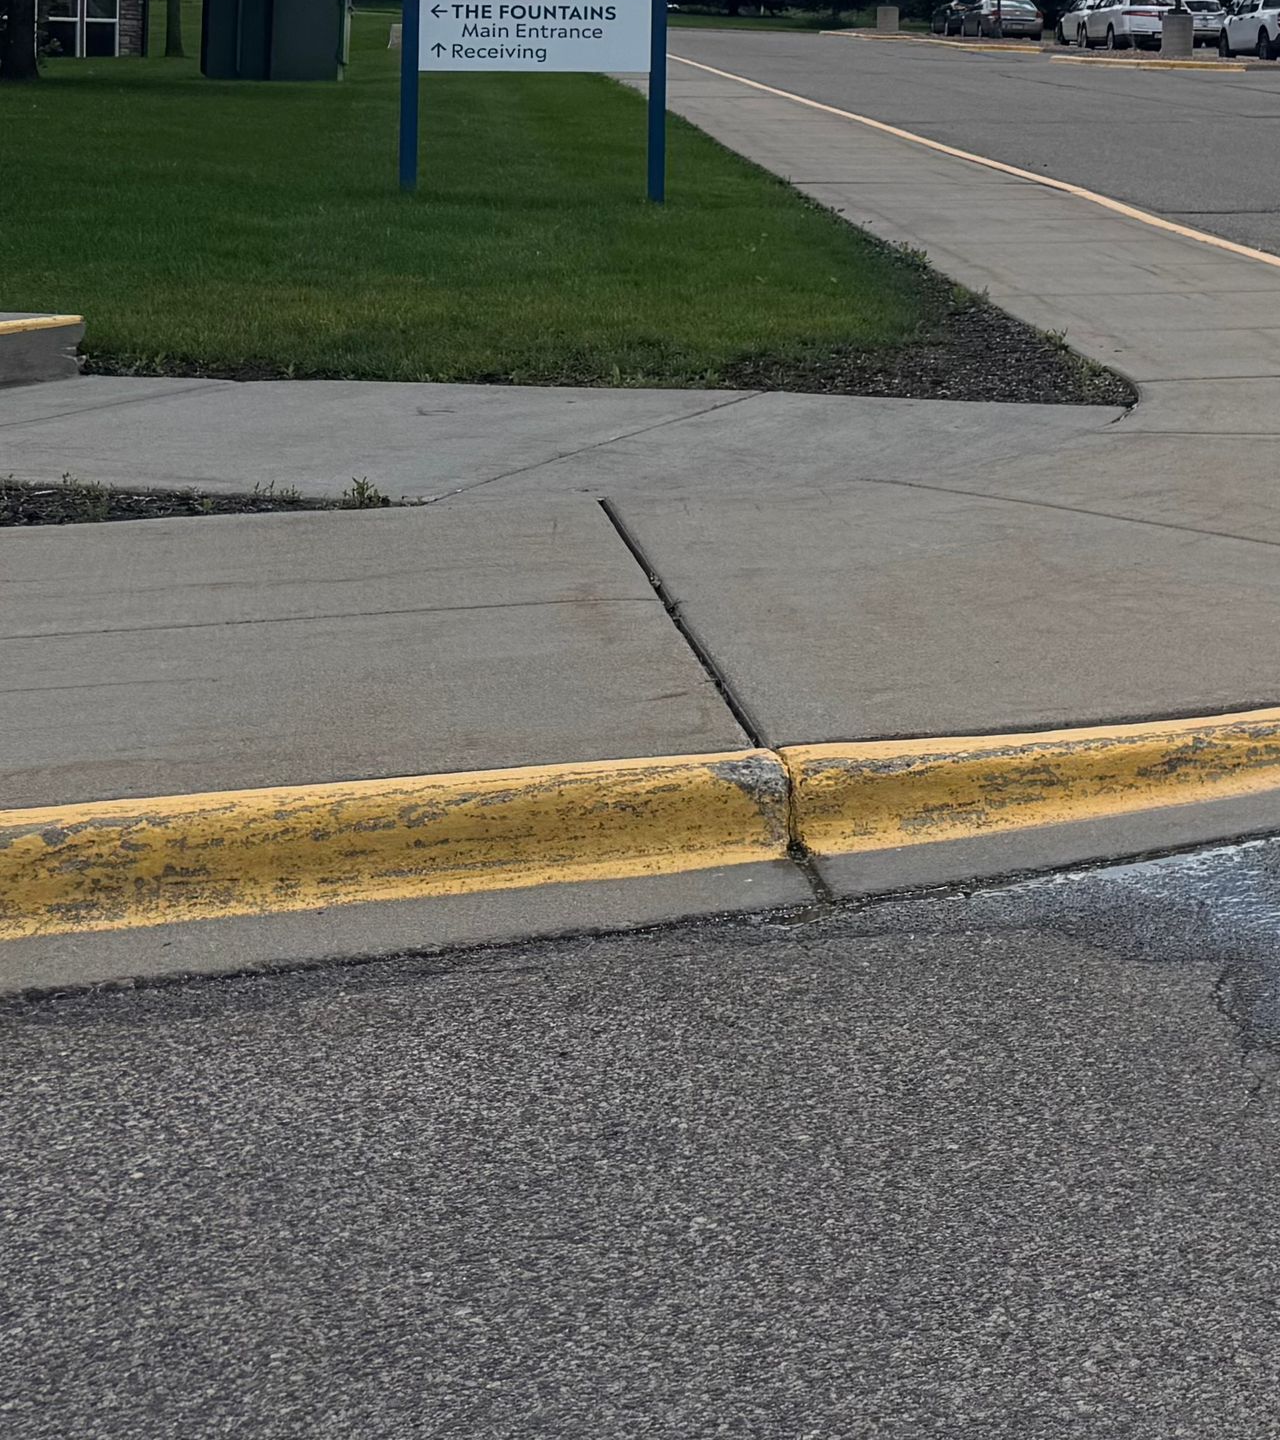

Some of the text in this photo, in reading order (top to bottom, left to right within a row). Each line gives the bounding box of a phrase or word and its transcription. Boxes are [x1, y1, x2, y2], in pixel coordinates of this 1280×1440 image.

[451, 4, 617, 21] THE FOUNTAINS
[462, 23, 603, 39] Main Entrance
[451, 43, 547, 62] Receiving
